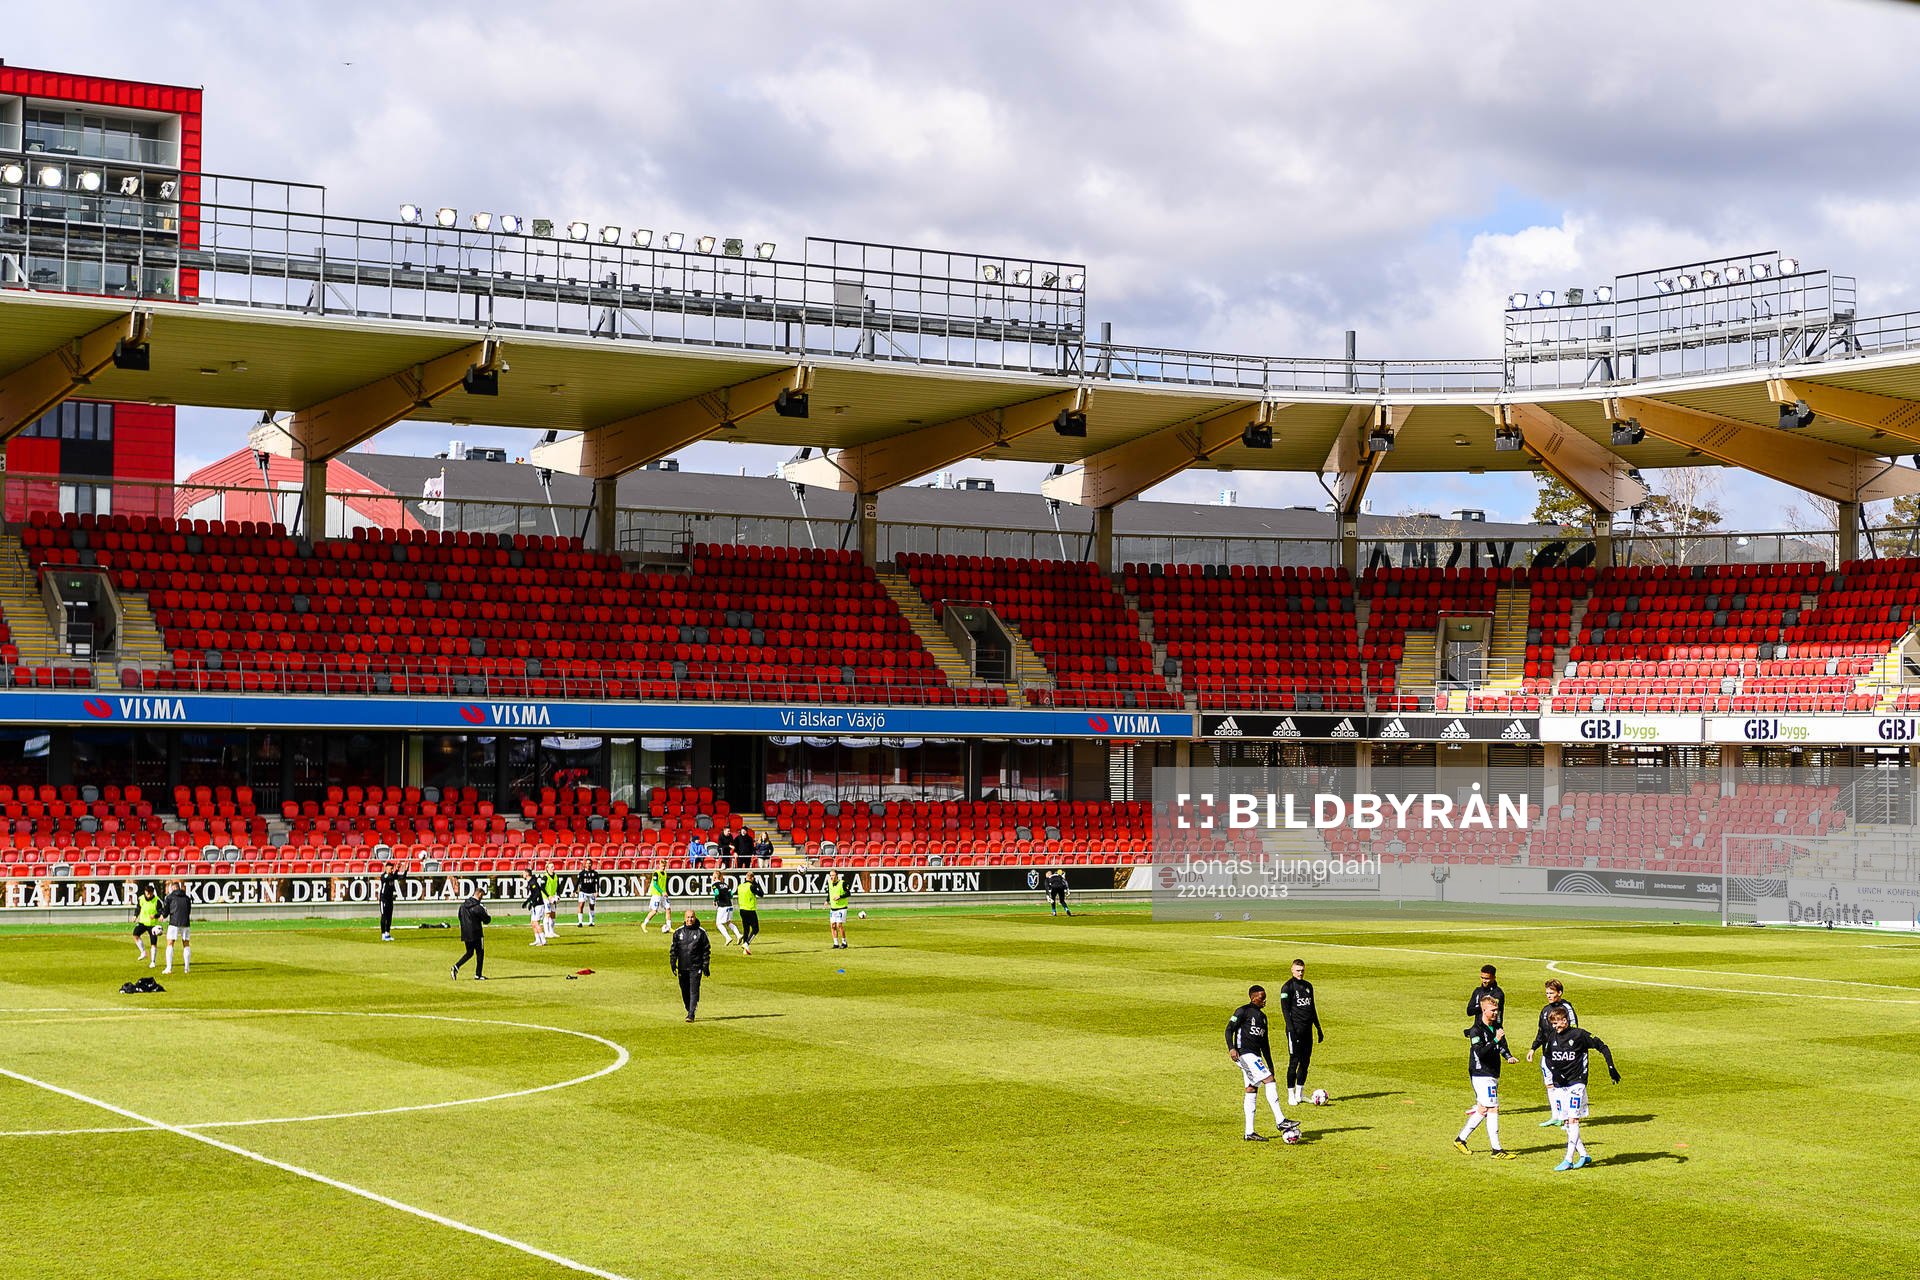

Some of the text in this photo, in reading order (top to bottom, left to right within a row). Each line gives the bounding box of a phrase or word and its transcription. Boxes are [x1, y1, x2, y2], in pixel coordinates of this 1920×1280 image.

[119, 697, 187, 721] VISMA
[491, 704, 551, 726] VISMA
[780, 711, 885, 732] Vi älskar Växjö
[1113, 715, 1161, 734] VISMA
[1214, 728, 1243, 737] adidas
[1272, 729, 1301, 738] adidas
[1330, 730, 1359, 738] adidas
[1380, 730, 1410, 739] adidas
[1440, 731, 1470, 740] adidas
[1501, 731, 1531, 740] adidas
[1580, 718, 1660, 741] GBJ bygg.
[1744, 718, 1810, 741] GBJ bygg.
[6, 880, 158, 908] HÅLLBAR
[168, 880, 288, 906] KOGEN,
[292, 881, 328, 903] DE
[723, 873, 769, 896] DN
[869, 871, 980, 894] IDROTTEN
[1615, 878, 1645, 890] stadium
[1789, 900, 1873, 925] Deloitte
[1552, 1051, 1576, 1061] SSAB
